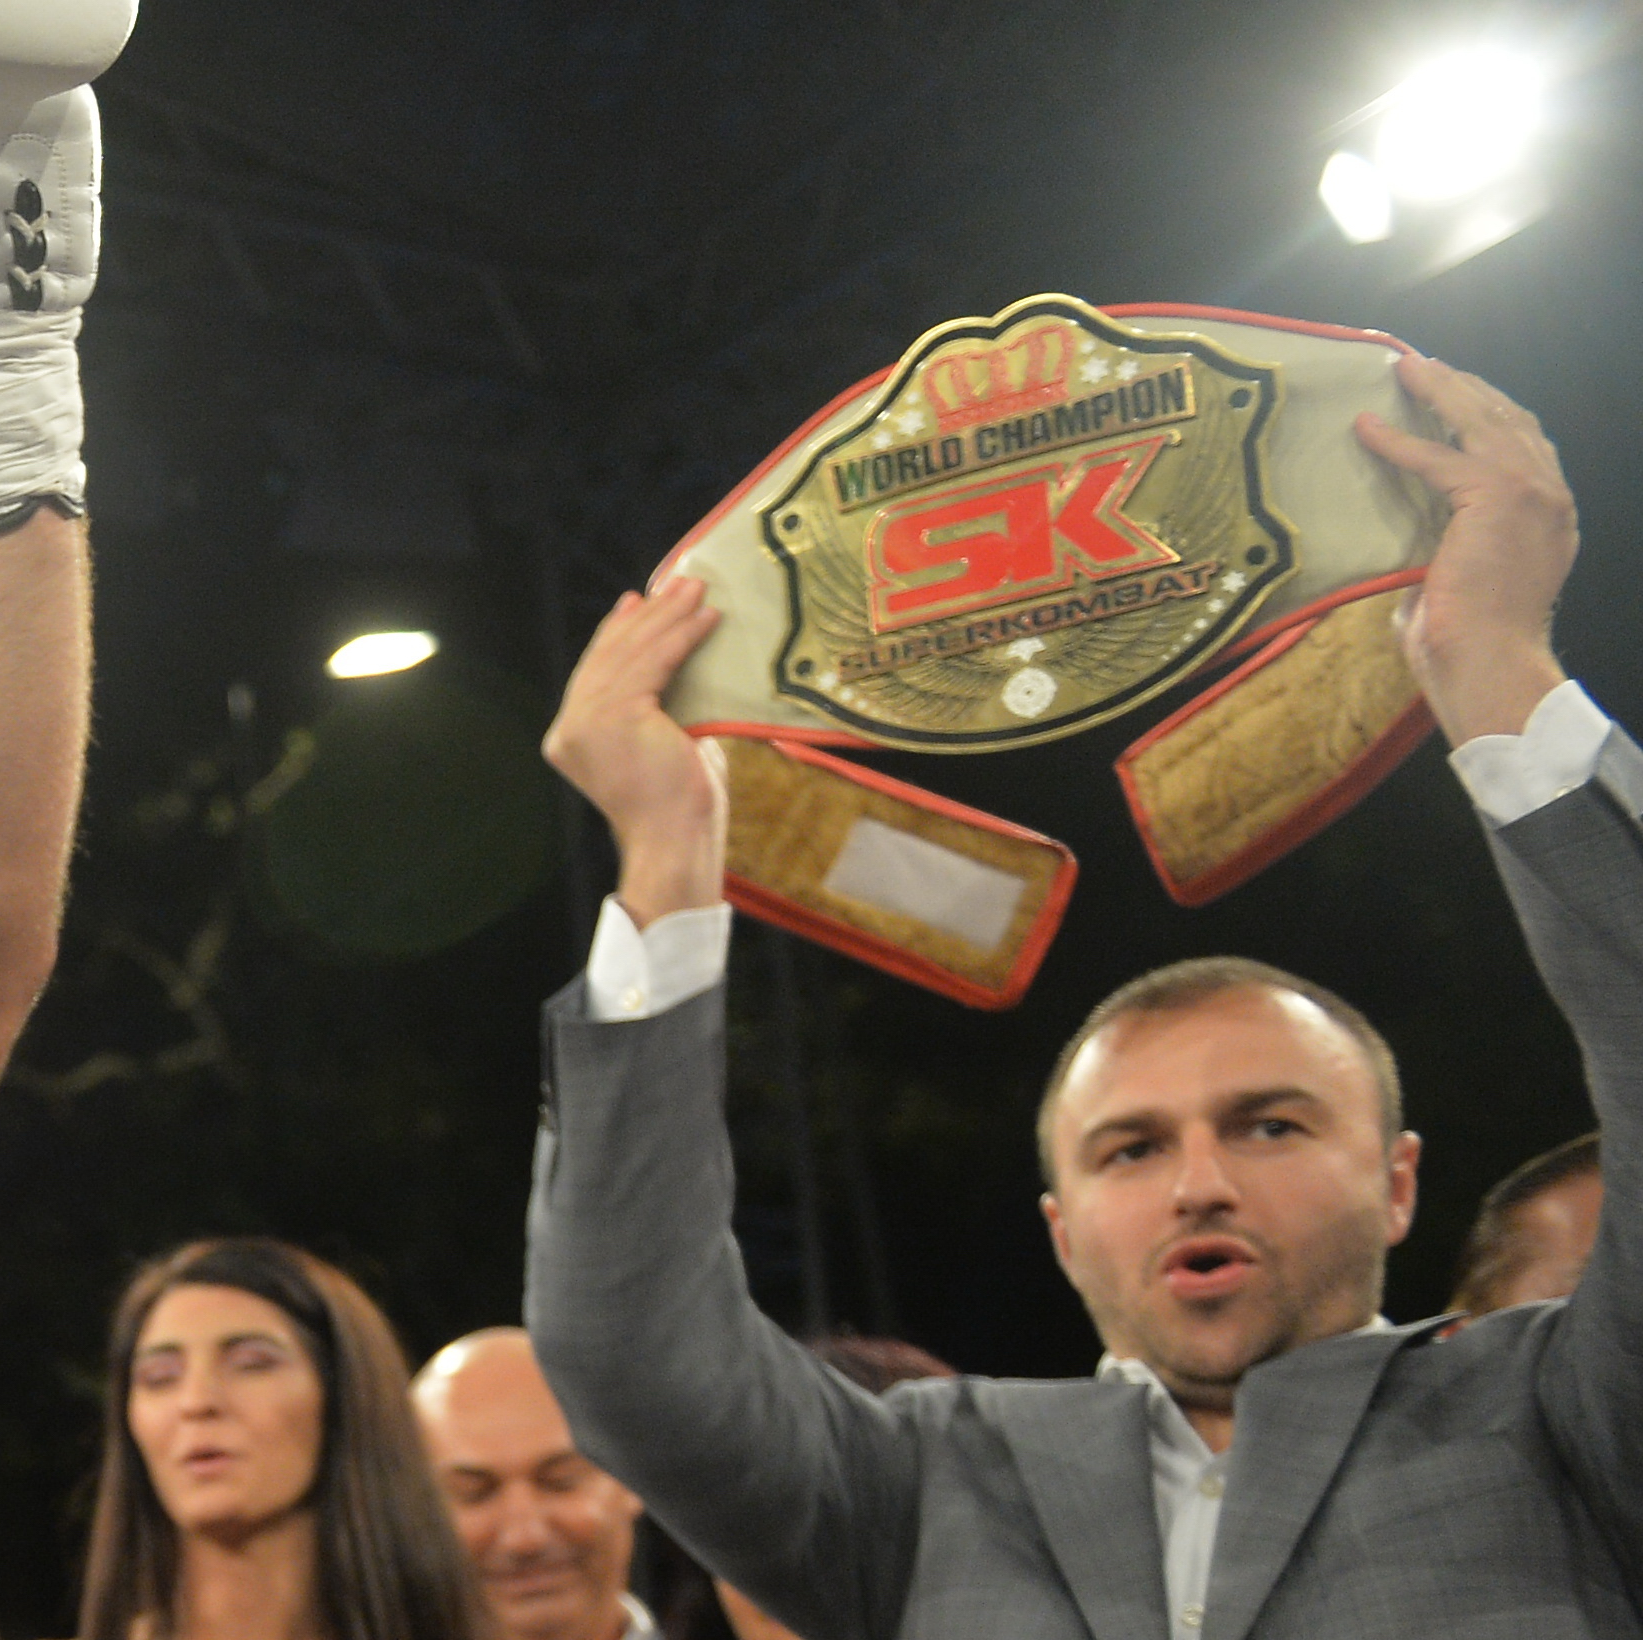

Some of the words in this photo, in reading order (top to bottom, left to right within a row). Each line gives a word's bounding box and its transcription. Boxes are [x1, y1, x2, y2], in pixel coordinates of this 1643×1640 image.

[834, 437, 962, 503] WORLD
[977, 366, 1188, 461] CHAMPION
[870, 435, 1179, 633] SK
[839, 564, 1217, 676] SUPERKOMBAT
